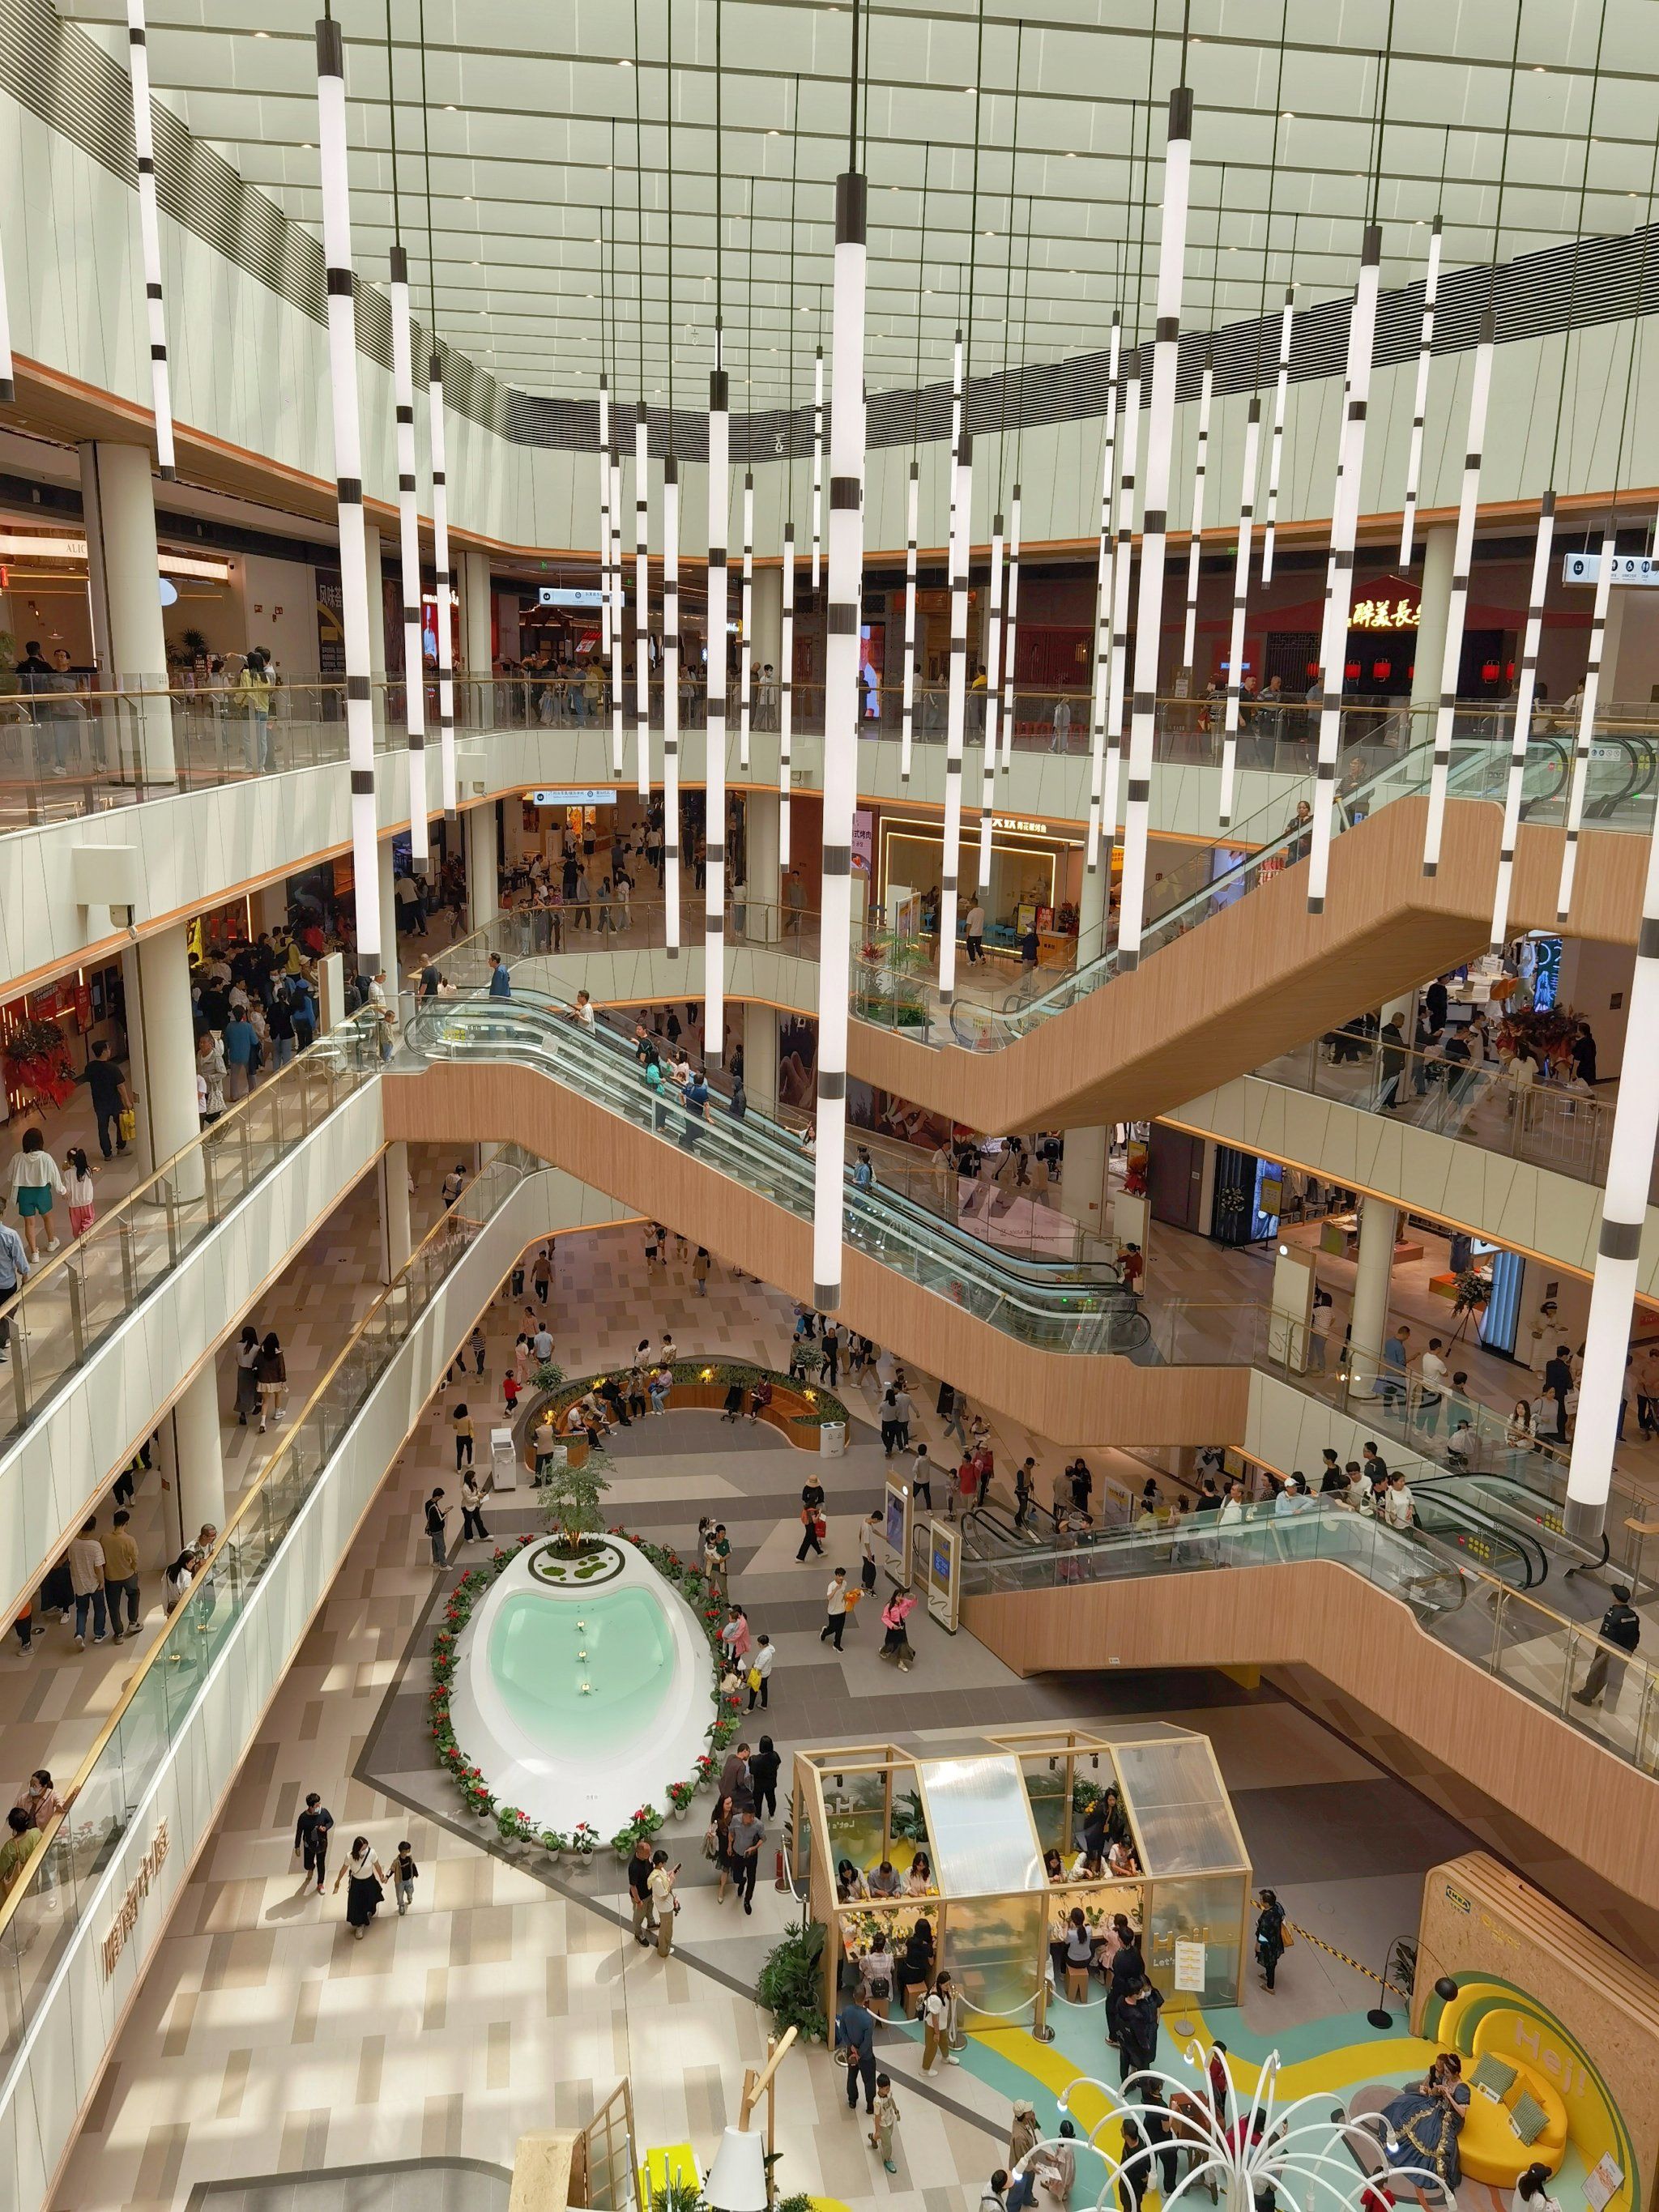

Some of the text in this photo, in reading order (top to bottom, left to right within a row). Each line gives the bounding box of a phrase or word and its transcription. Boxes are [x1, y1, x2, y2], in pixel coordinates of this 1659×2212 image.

[852, 829, 872, 840] 式烤肉
[1448, 1888, 1469, 1910] IKEA
[1516, 2017, 1588, 2098] Hej!
